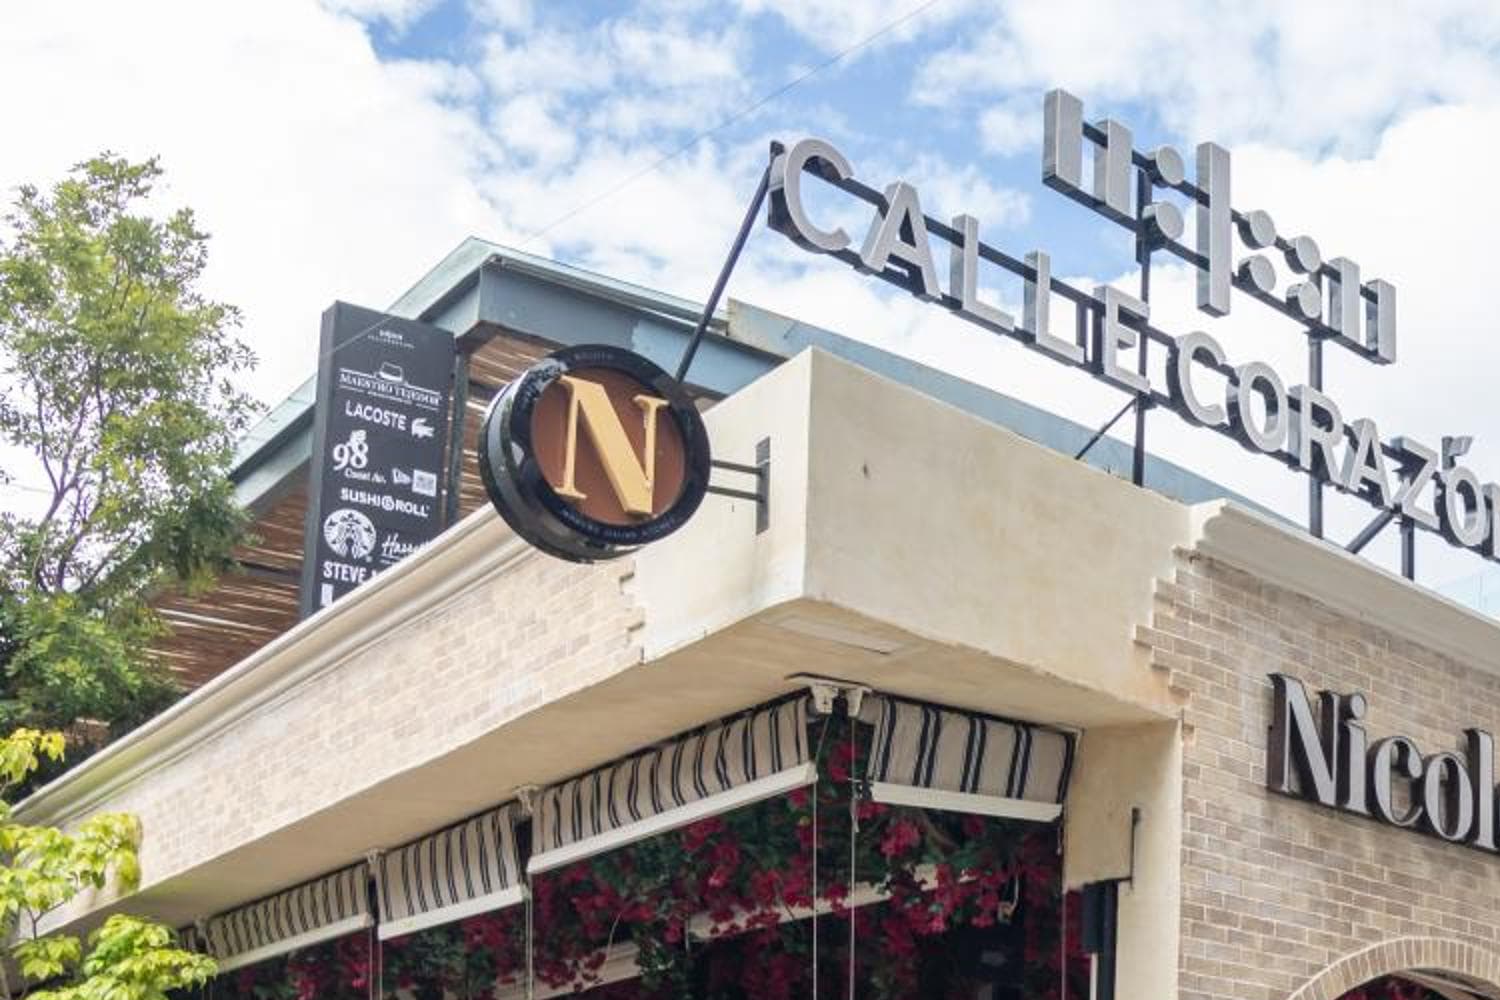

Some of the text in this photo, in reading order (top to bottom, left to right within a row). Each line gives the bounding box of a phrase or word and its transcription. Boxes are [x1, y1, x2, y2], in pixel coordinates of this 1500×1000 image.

[769, 137, 1149, 393] CALLE
[345, 399, 407, 431] LACOSTE
[332, 441, 369, 471] 98
[554, 374, 670, 514] N
[323, 561, 367, 583] STEVE
